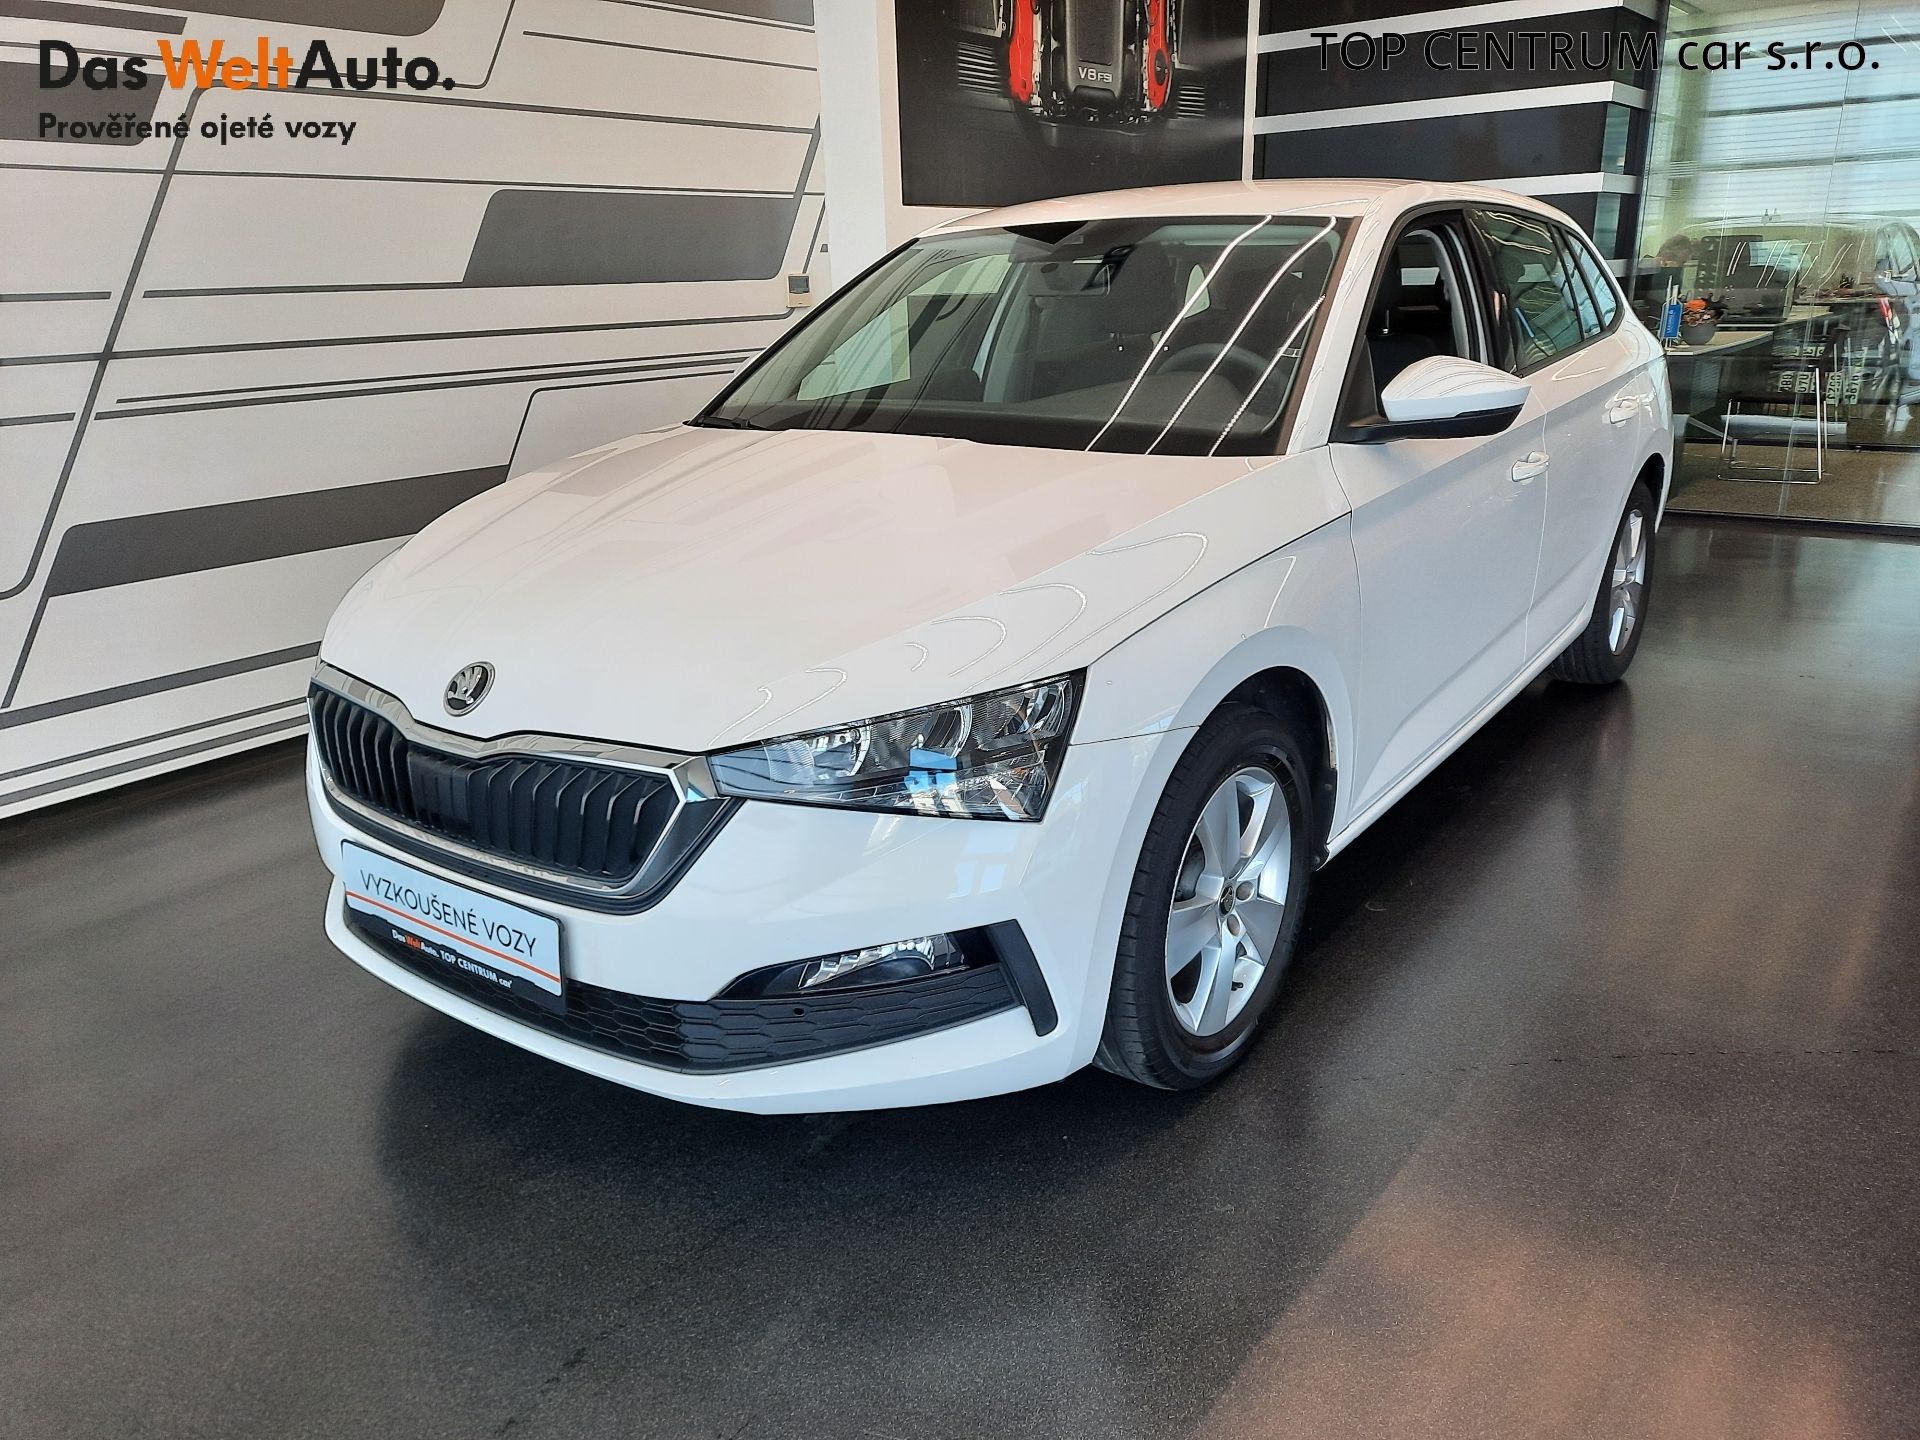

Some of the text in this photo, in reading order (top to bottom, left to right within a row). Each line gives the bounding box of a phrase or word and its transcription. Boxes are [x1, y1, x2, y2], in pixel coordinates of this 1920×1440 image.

[360, 869, 538, 958] VYZKOUŠENÉ VOZY
[439, 950, 457, 964] TOP
[457, 958, 499, 983] CENTRUM
